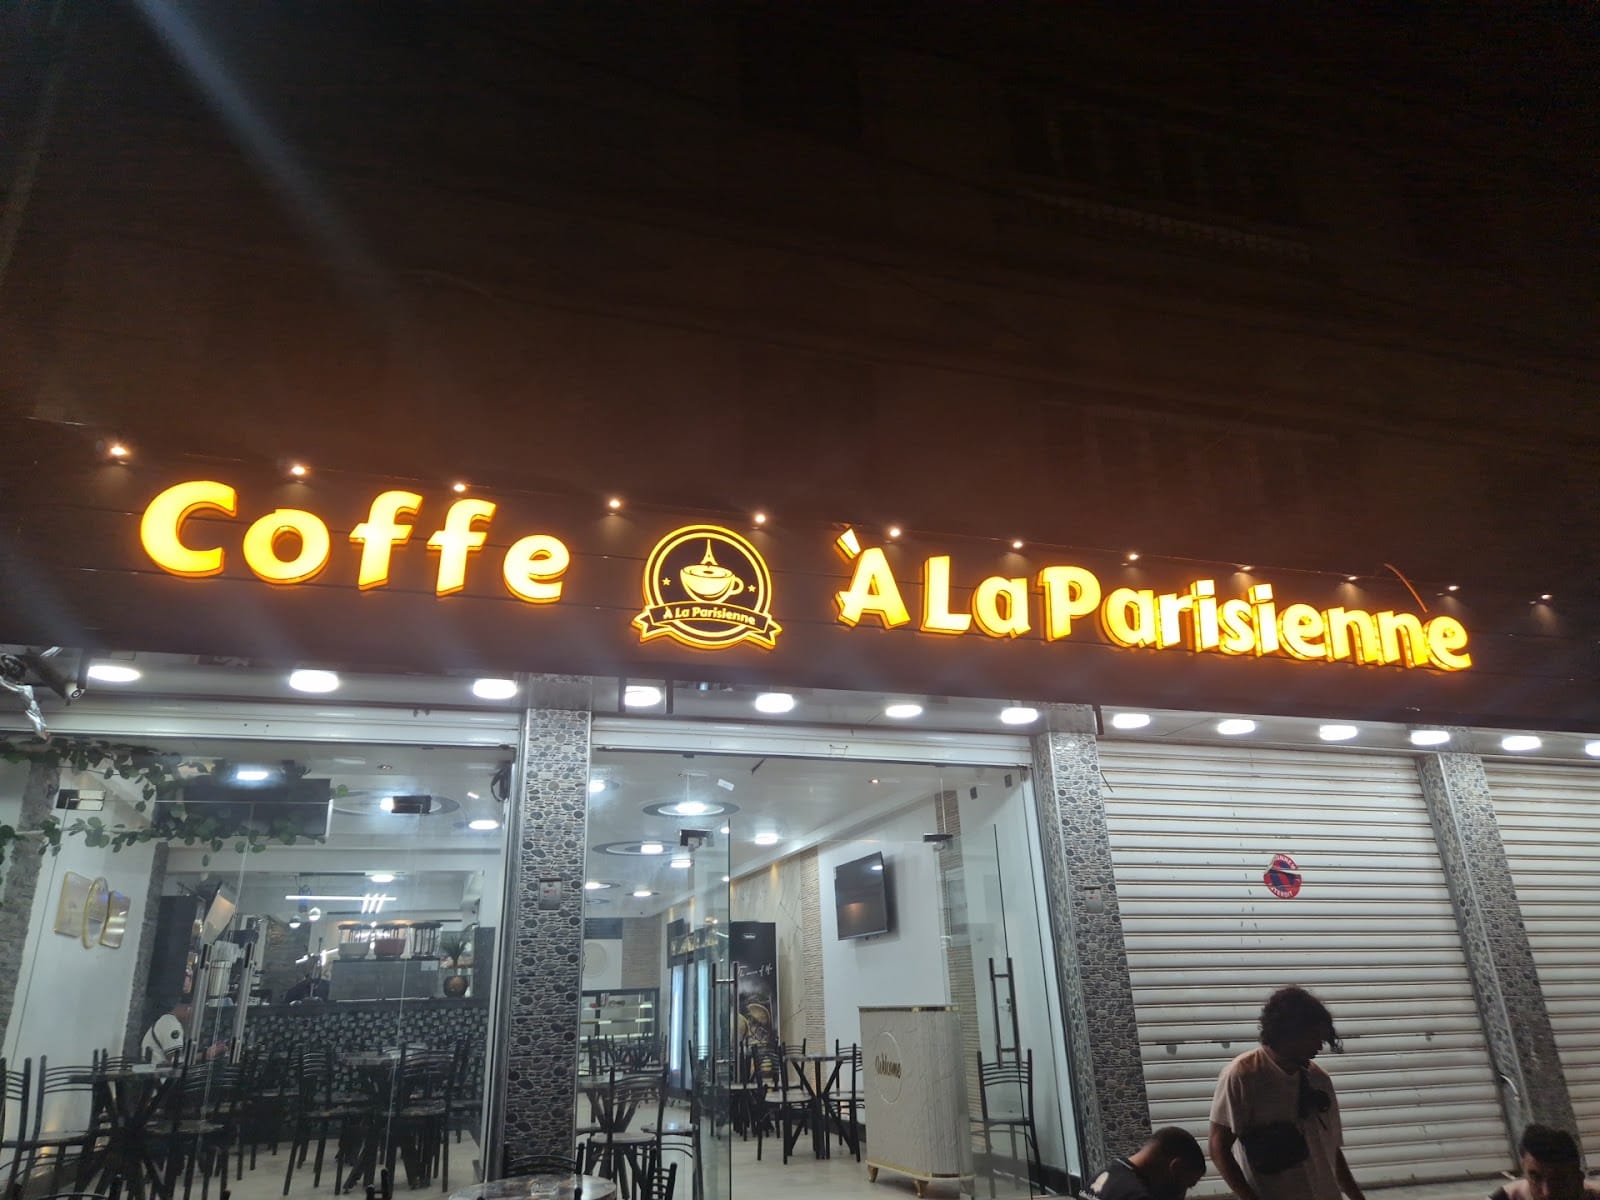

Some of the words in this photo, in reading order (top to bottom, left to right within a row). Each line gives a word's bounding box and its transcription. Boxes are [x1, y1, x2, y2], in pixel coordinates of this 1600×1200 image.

[139, 480, 571, 603] Coffe
[835, 527, 911, 630] À
[920, 554, 1031, 638] La
[1038, 564, 1472, 672] Parisienne
[663, 606, 673, 619] À
[675, 607, 690, 618] La
[692, 606, 756, 625] Parisienne
